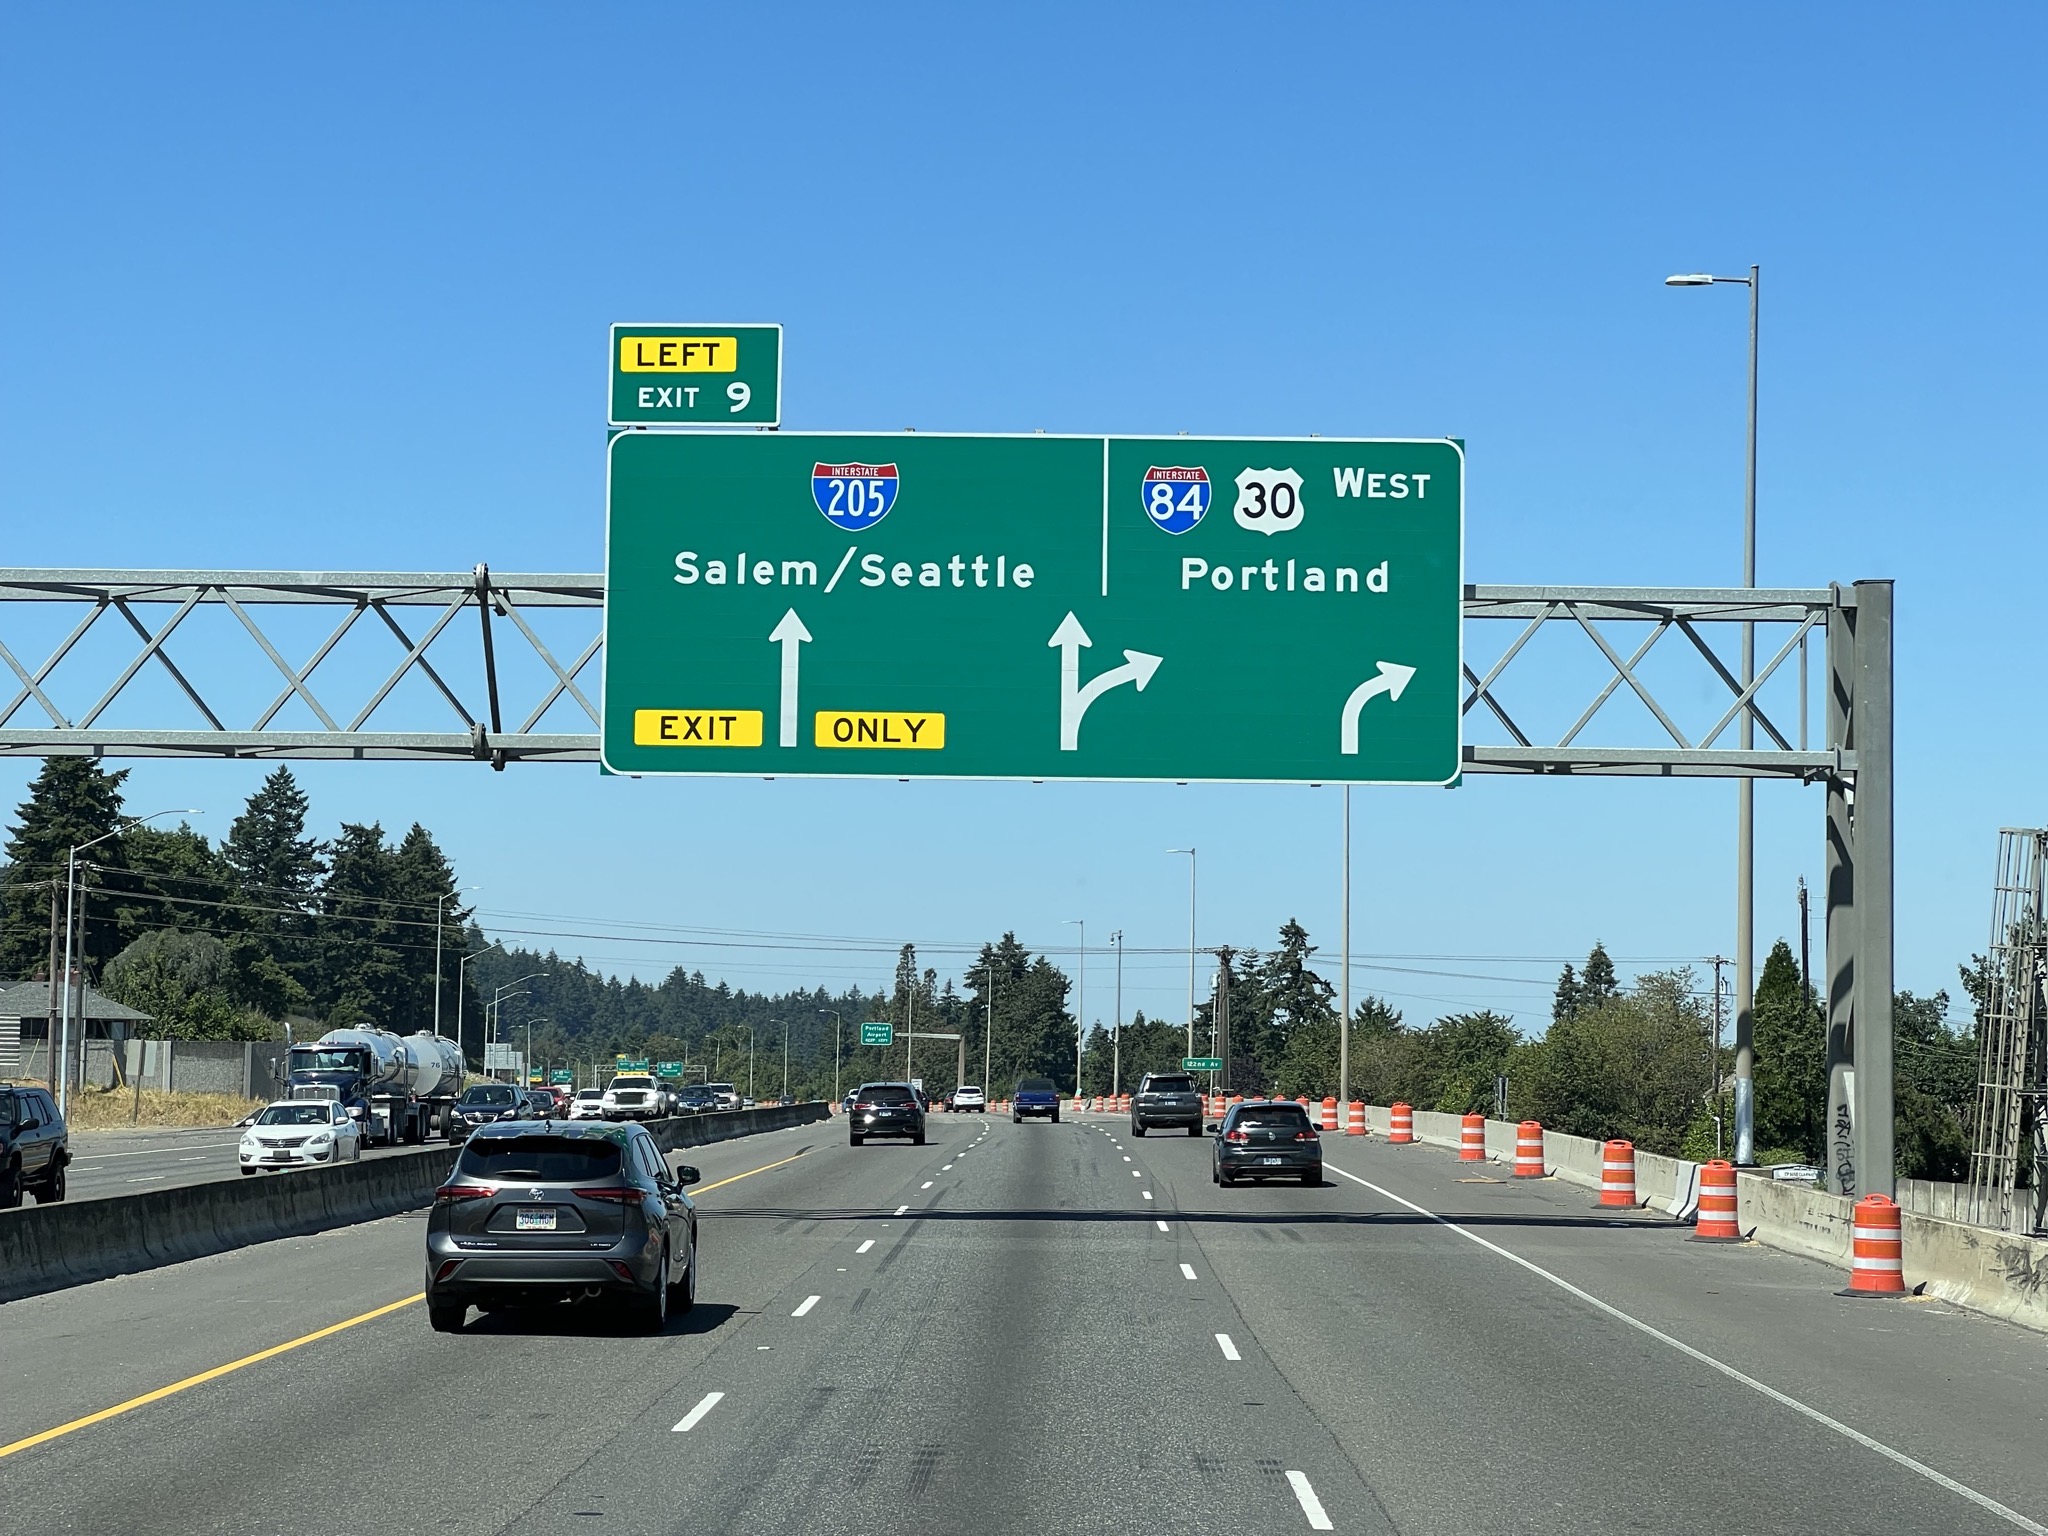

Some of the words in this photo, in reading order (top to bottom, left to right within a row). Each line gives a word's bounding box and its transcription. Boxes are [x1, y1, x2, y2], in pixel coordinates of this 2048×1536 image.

[637, 342, 720, 367] LEFT
[638, 387, 700, 408] EXIT
[726, 381, 751, 413] 9
[831, 466, 879, 477] INTERSTATE
[1153, 470, 1201, 480] INTERSTATE
[1333, 467, 1431, 499] WEST
[828, 479, 885, 517] 205
[1150, 483, 1204, 520] 84
[1242, 481, 1296, 519] 30
[673, 546, 1035, 593] Salem/Seattle
[1182, 557, 1388, 593] Portland
[660, 715, 737, 741] EXIT
[833, 717, 926, 743] ONLY
[430, 1061, 441, 1069] 76
